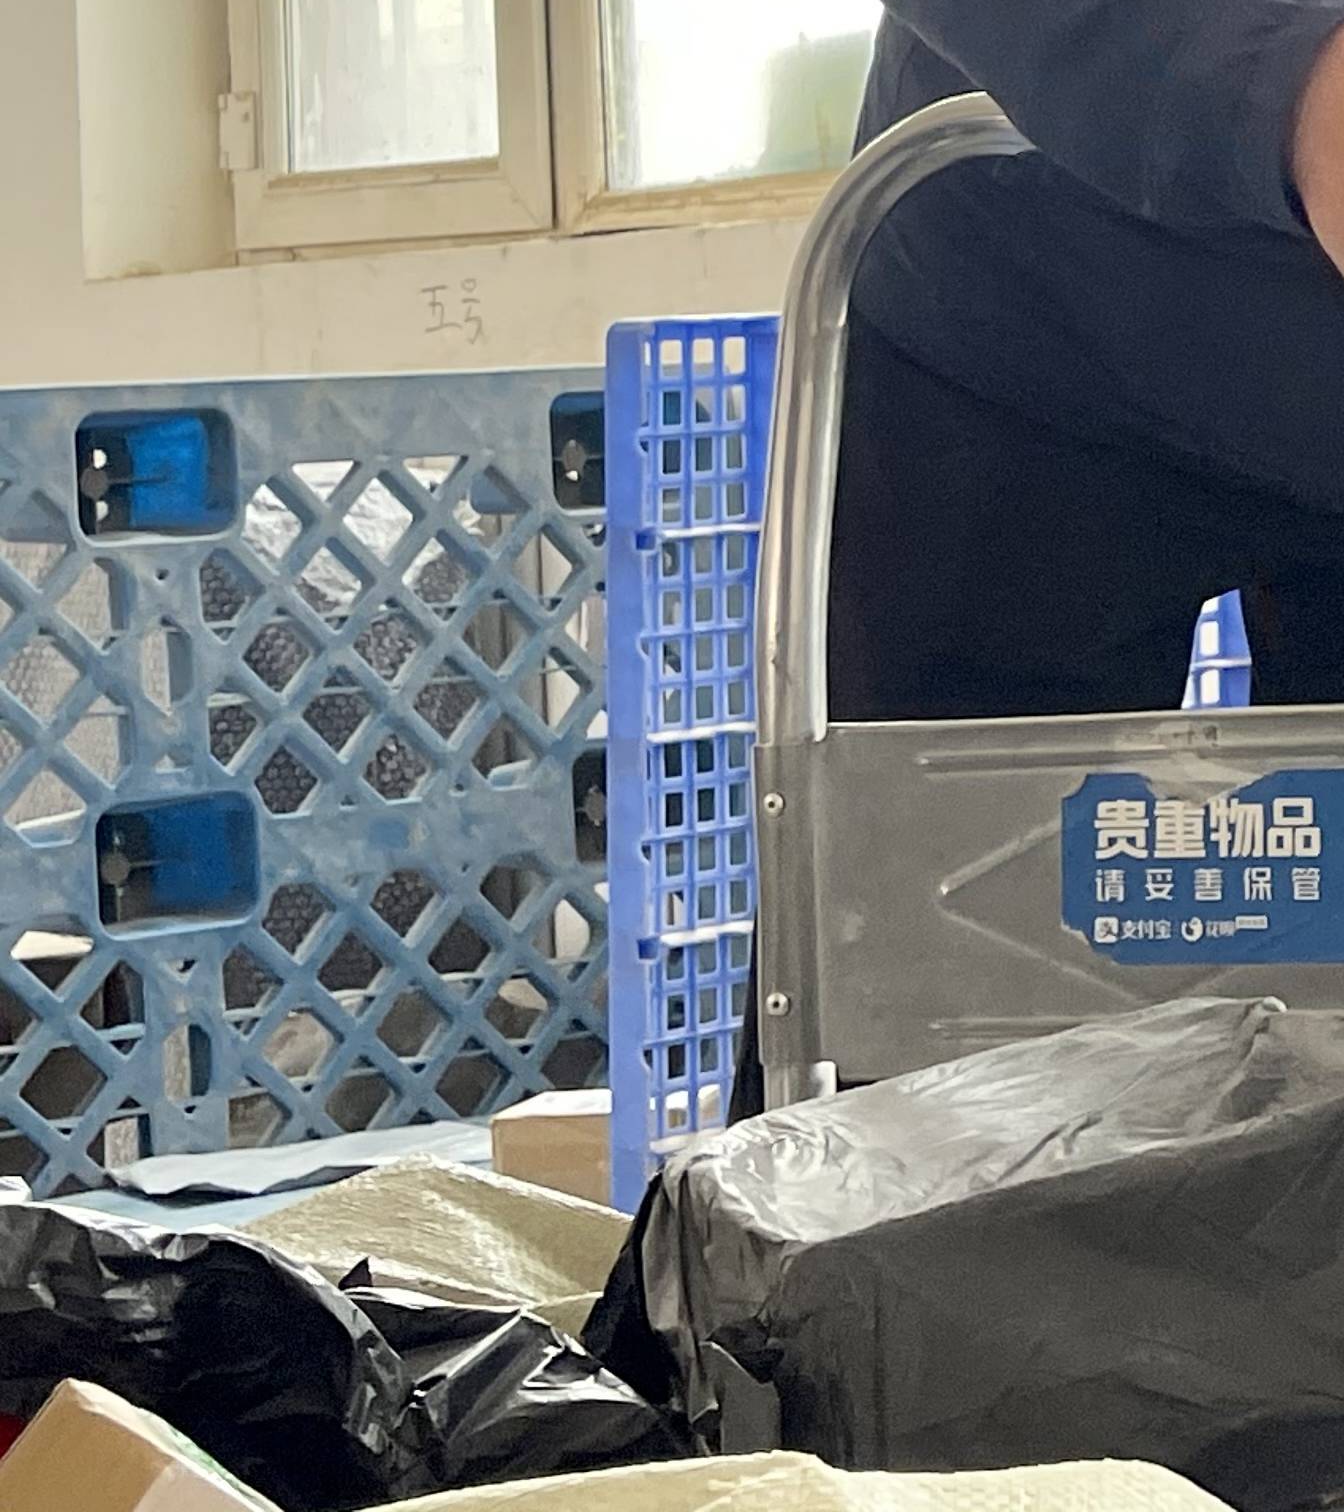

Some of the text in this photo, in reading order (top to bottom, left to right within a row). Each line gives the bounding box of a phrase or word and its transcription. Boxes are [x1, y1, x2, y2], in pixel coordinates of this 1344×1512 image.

[420, 277, 483, 345] 五号
[1094, 797, 1322, 860] 贵重物品
[1095, 866, 1321, 903] 请妥善保管
[1121, 919, 1172, 939] 支付宝
